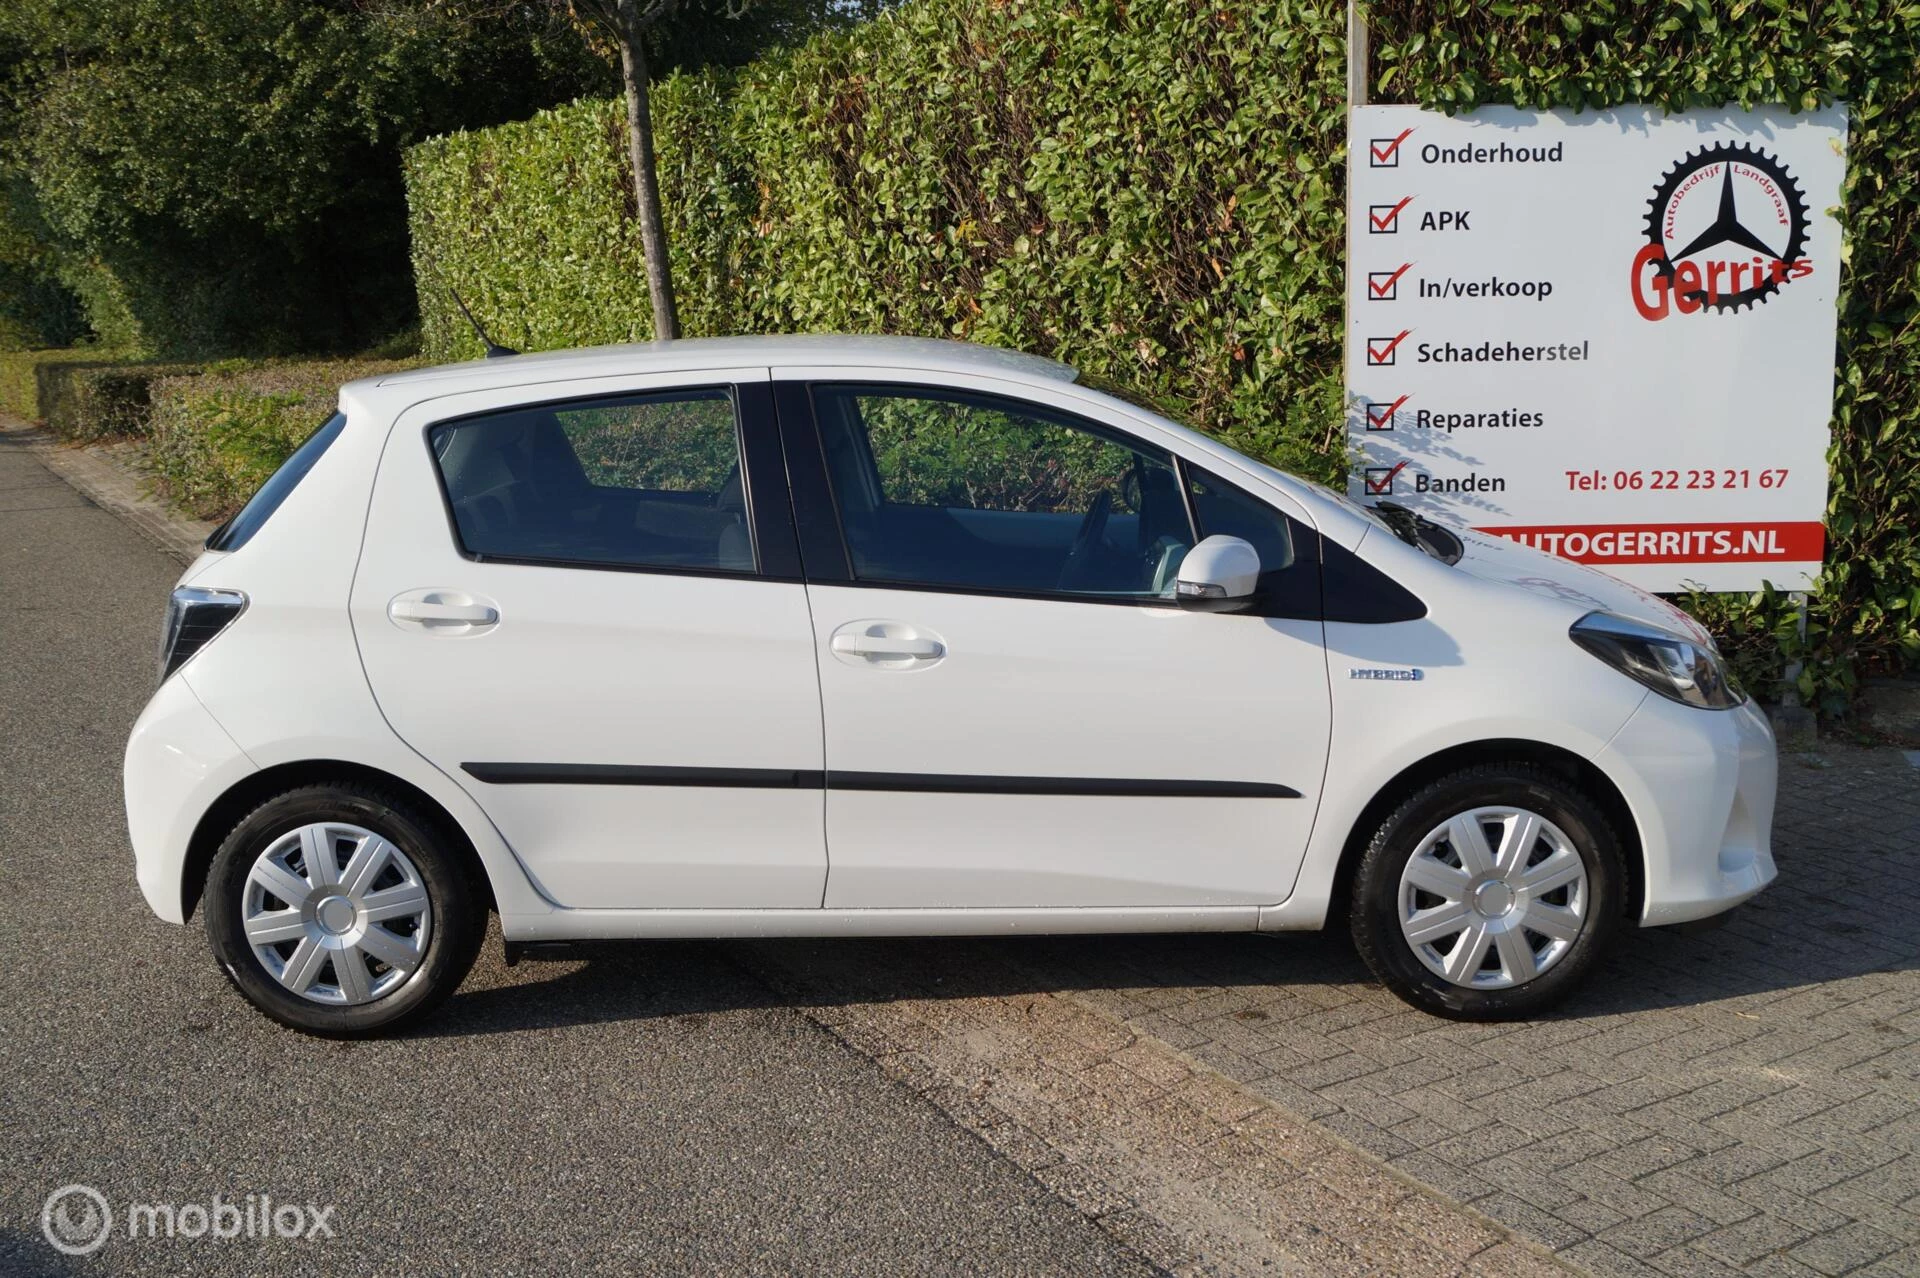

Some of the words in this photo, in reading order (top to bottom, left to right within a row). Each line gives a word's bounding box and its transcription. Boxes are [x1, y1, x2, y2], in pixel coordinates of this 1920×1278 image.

[1421, 141, 1563, 165] Onderhoud
[1664, 164, 1720, 240] Autobedrijf
[1733, 164, 1789, 227] Landgraaf
[1420, 211, 1471, 232] APK
[1419, 276, 1553, 302] In/verkoop
[1630, 243, 1814, 322] Gerrits
[1417, 340, 1589, 363] Schadeherstel
[1416, 408, 1544, 434] Reparaties
[1415, 472, 1506, 494] Banden
[1565, 470, 1607, 491] Tel:
[1613, 470, 1643, 491] 06
[1650, 470, 1679, 490] 22
[1687, 470, 1715, 490] 23
[1723, 469, 1749, 489] 21
[1758, 469, 1789, 489] 67
